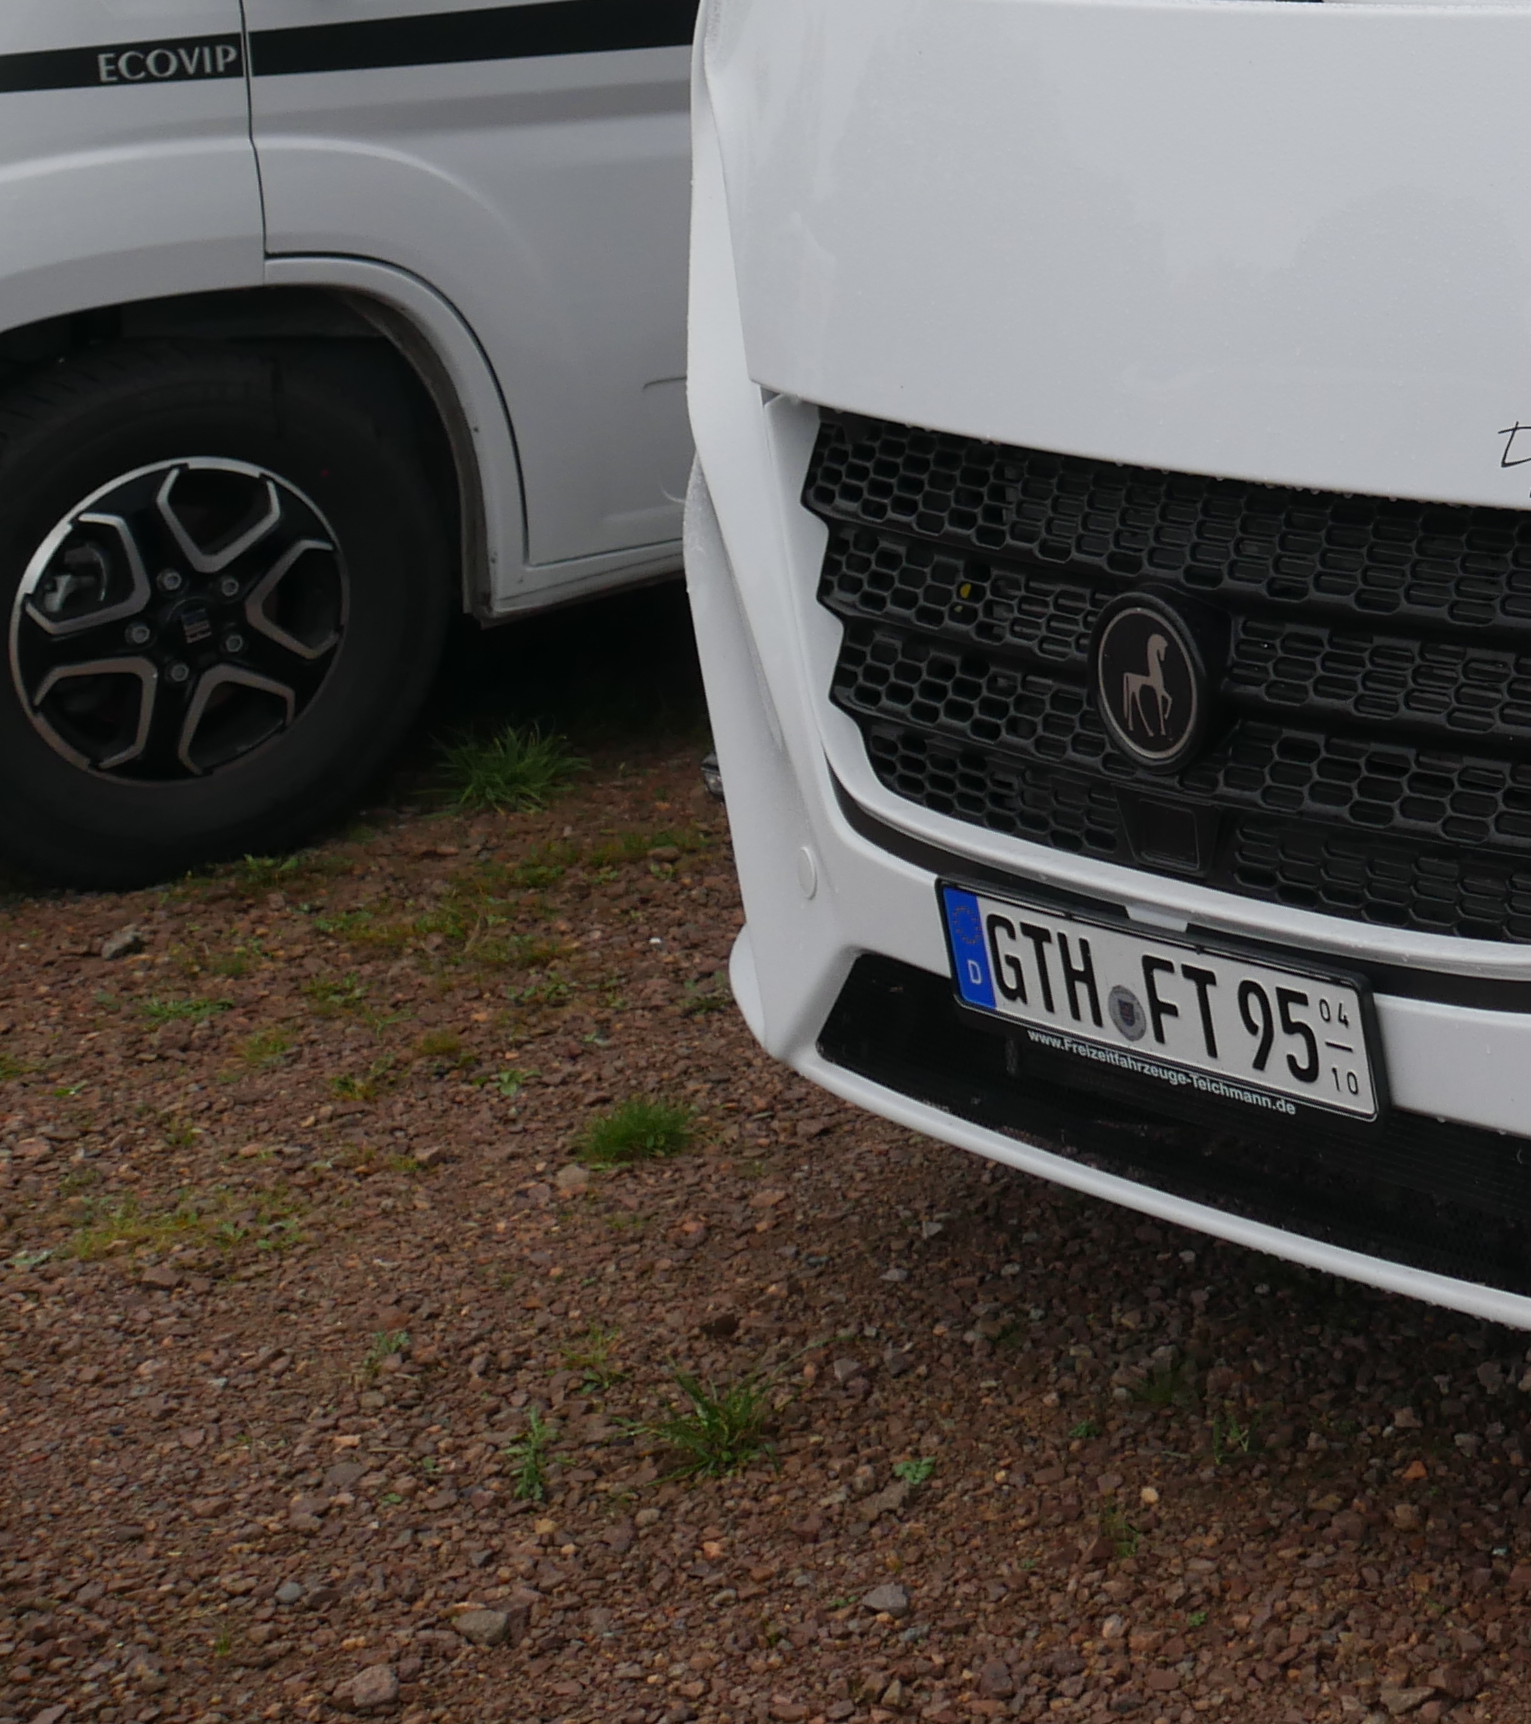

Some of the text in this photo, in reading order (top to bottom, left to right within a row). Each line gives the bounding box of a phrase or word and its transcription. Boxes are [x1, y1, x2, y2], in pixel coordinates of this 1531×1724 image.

[97, 44, 237, 83] ECOVIP
[967, 958, 983, 985] D
[986, 913, 1103, 1029] GTH
[1318, 997, 1351, 1029] 04
[1027, 1028, 1297, 1116] www.Freizeitfahrzeuge-Teichmann.de
[1330, 1066, 1359, 1096] 10
